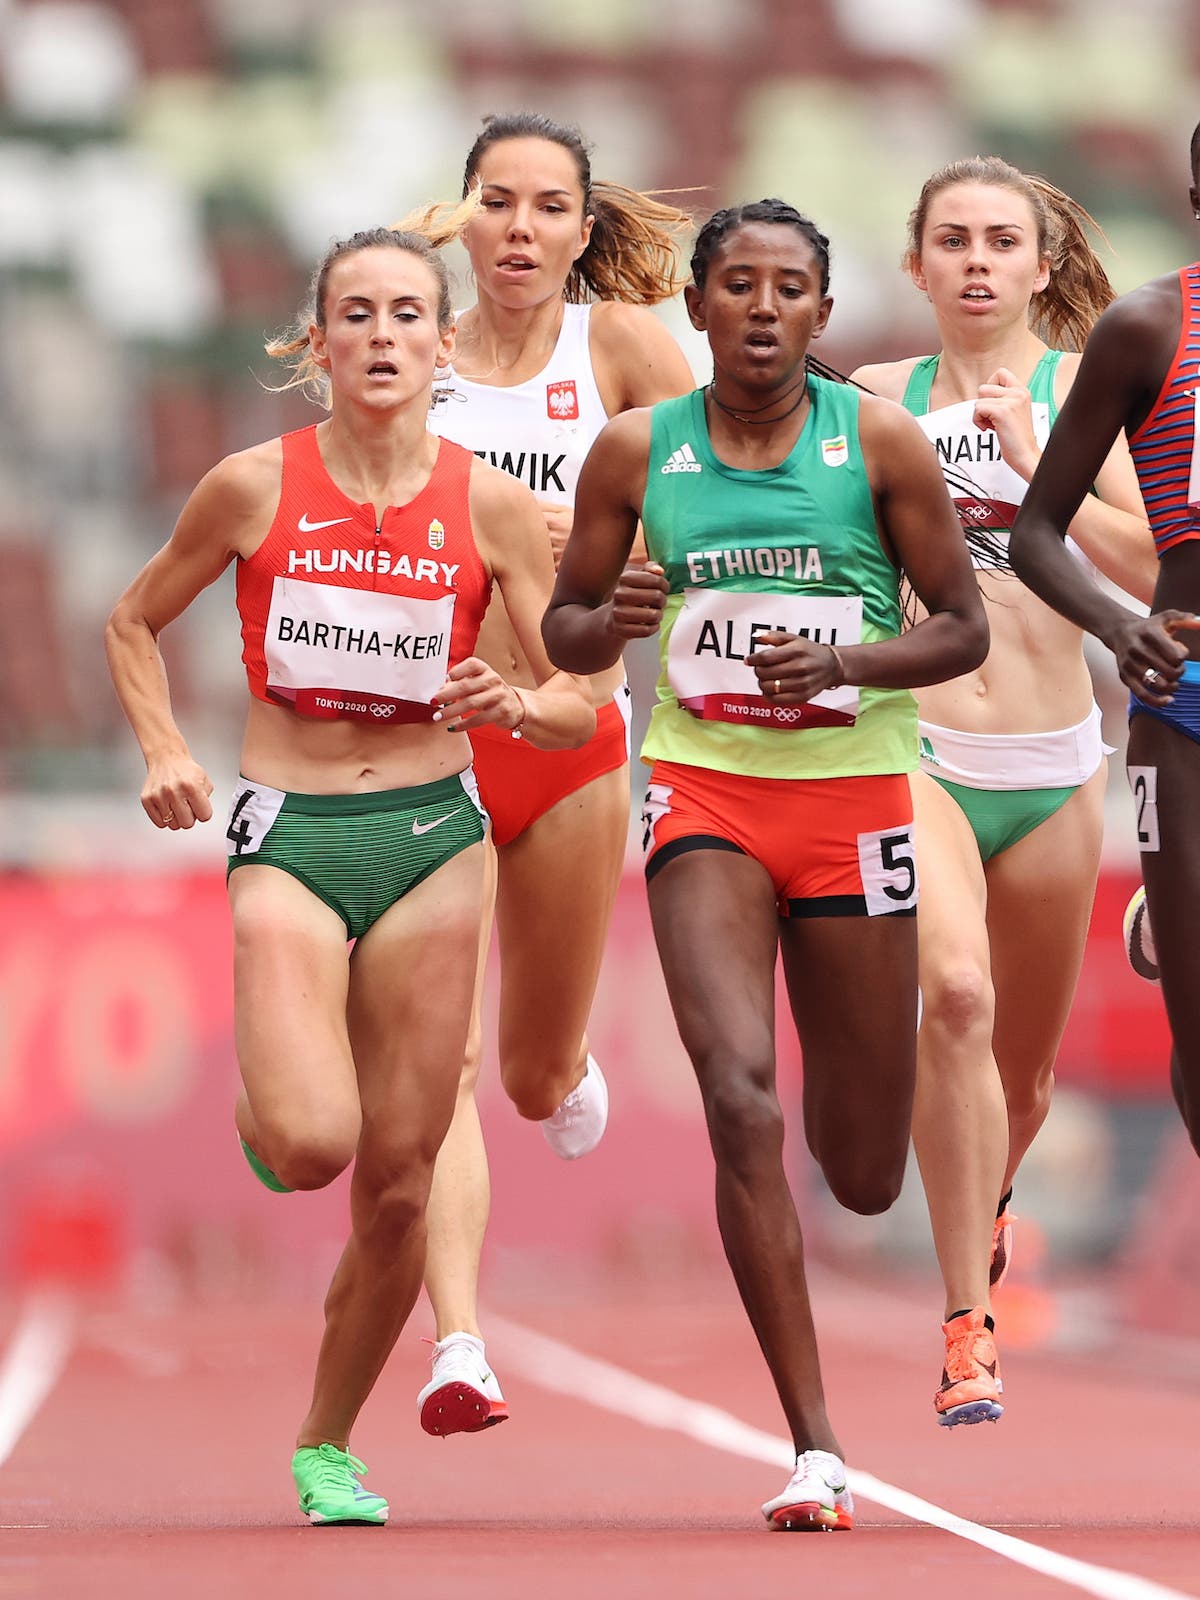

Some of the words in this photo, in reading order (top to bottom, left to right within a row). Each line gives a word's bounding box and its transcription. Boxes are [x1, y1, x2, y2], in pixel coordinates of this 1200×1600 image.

[936, 433, 1002, 464] NAH
[473, 450, 567, 492] WIK
[661, 463, 703, 475] adidas
[286, 549, 460, 586] HUNGARY
[686, 547, 824, 584] ETHIOPIA
[277, 616, 444, 660] BARTHA-KERI
[315, 697, 344, 710] TOKYO
[345, 702, 367, 713] 2020
[722, 703, 749, 715] TOKYO
[750, 707, 771, 718] 2020
[226, 789, 257, 855] 4
[1134, 775, 1150, 843] 2
[879, 833, 916, 901] 5
